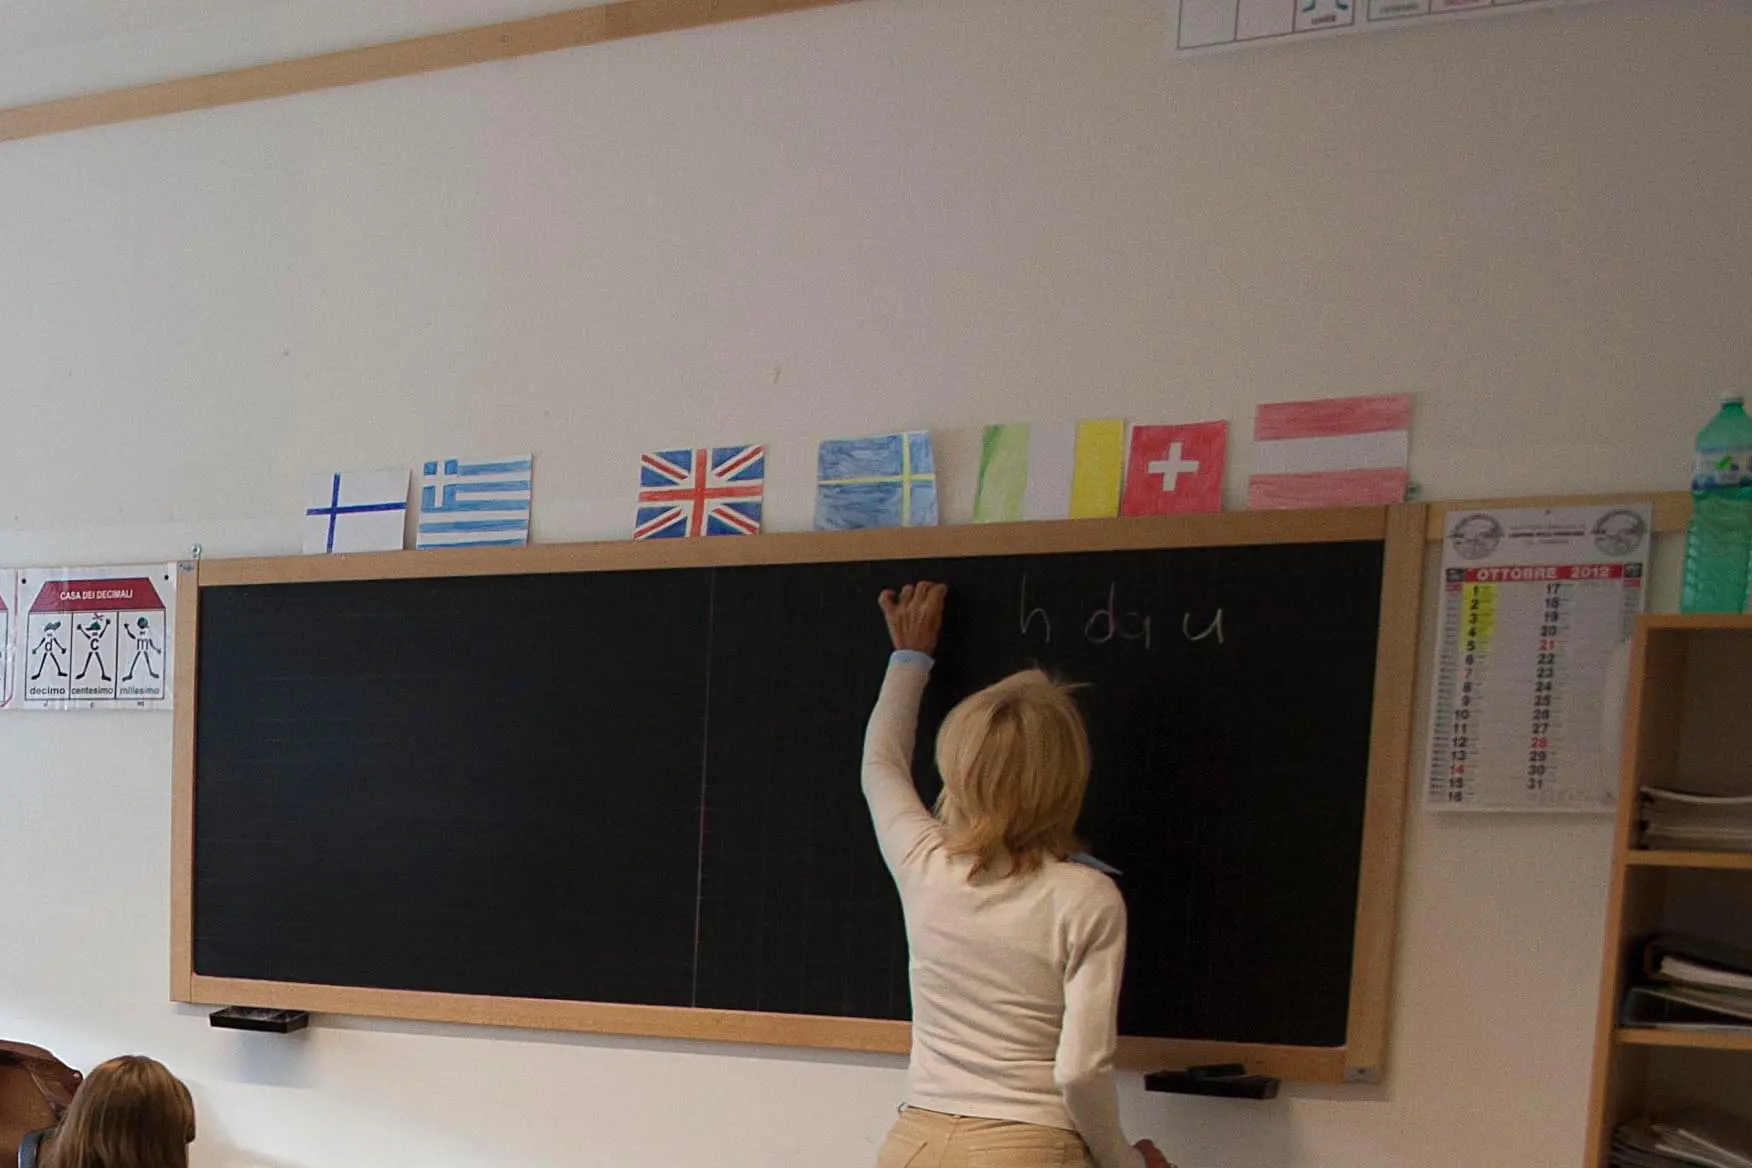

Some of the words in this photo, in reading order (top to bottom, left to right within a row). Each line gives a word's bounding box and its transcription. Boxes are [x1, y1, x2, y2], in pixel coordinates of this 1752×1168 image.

[1476, 567, 1557, 581] OTTOBRE
[1571, 566, 1610, 579] 2012
[1546, 583, 1560, 594] 17
[60, 591, 81, 600] CASA
[82, 591, 96, 600] DEI
[97, 589, 133, 599] DECIMALI
[1020, 572, 1051, 644] h
[1182, 607, 1225, 644] u
[1544, 611, 1558, 622] 19
[1540, 625, 1557, 637] 20
[1539, 639, 1554, 651] 21
[1537, 653, 1554, 665] 22
[1536, 667, 1553, 678] 23
[30, 686, 66, 695] decimo
[71, 685, 114, 695] centesimo
[119, 685, 160, 695] millesimo
[1535, 681, 1552, 692] 24
[1533, 695, 1551, 706] 25
[1455, 709, 1469, 720] 10
[1454, 723, 1467, 734] 11
[1532, 722, 1548, 734] 27
[1452, 737, 1467, 748] 12
[1451, 750, 1466, 761] 13
[1529, 750, 1547, 762] 29
[1528, 764, 1545, 775] 30
[1449, 778, 1463, 789] 15
[1527, 778, 1543, 789] 31
